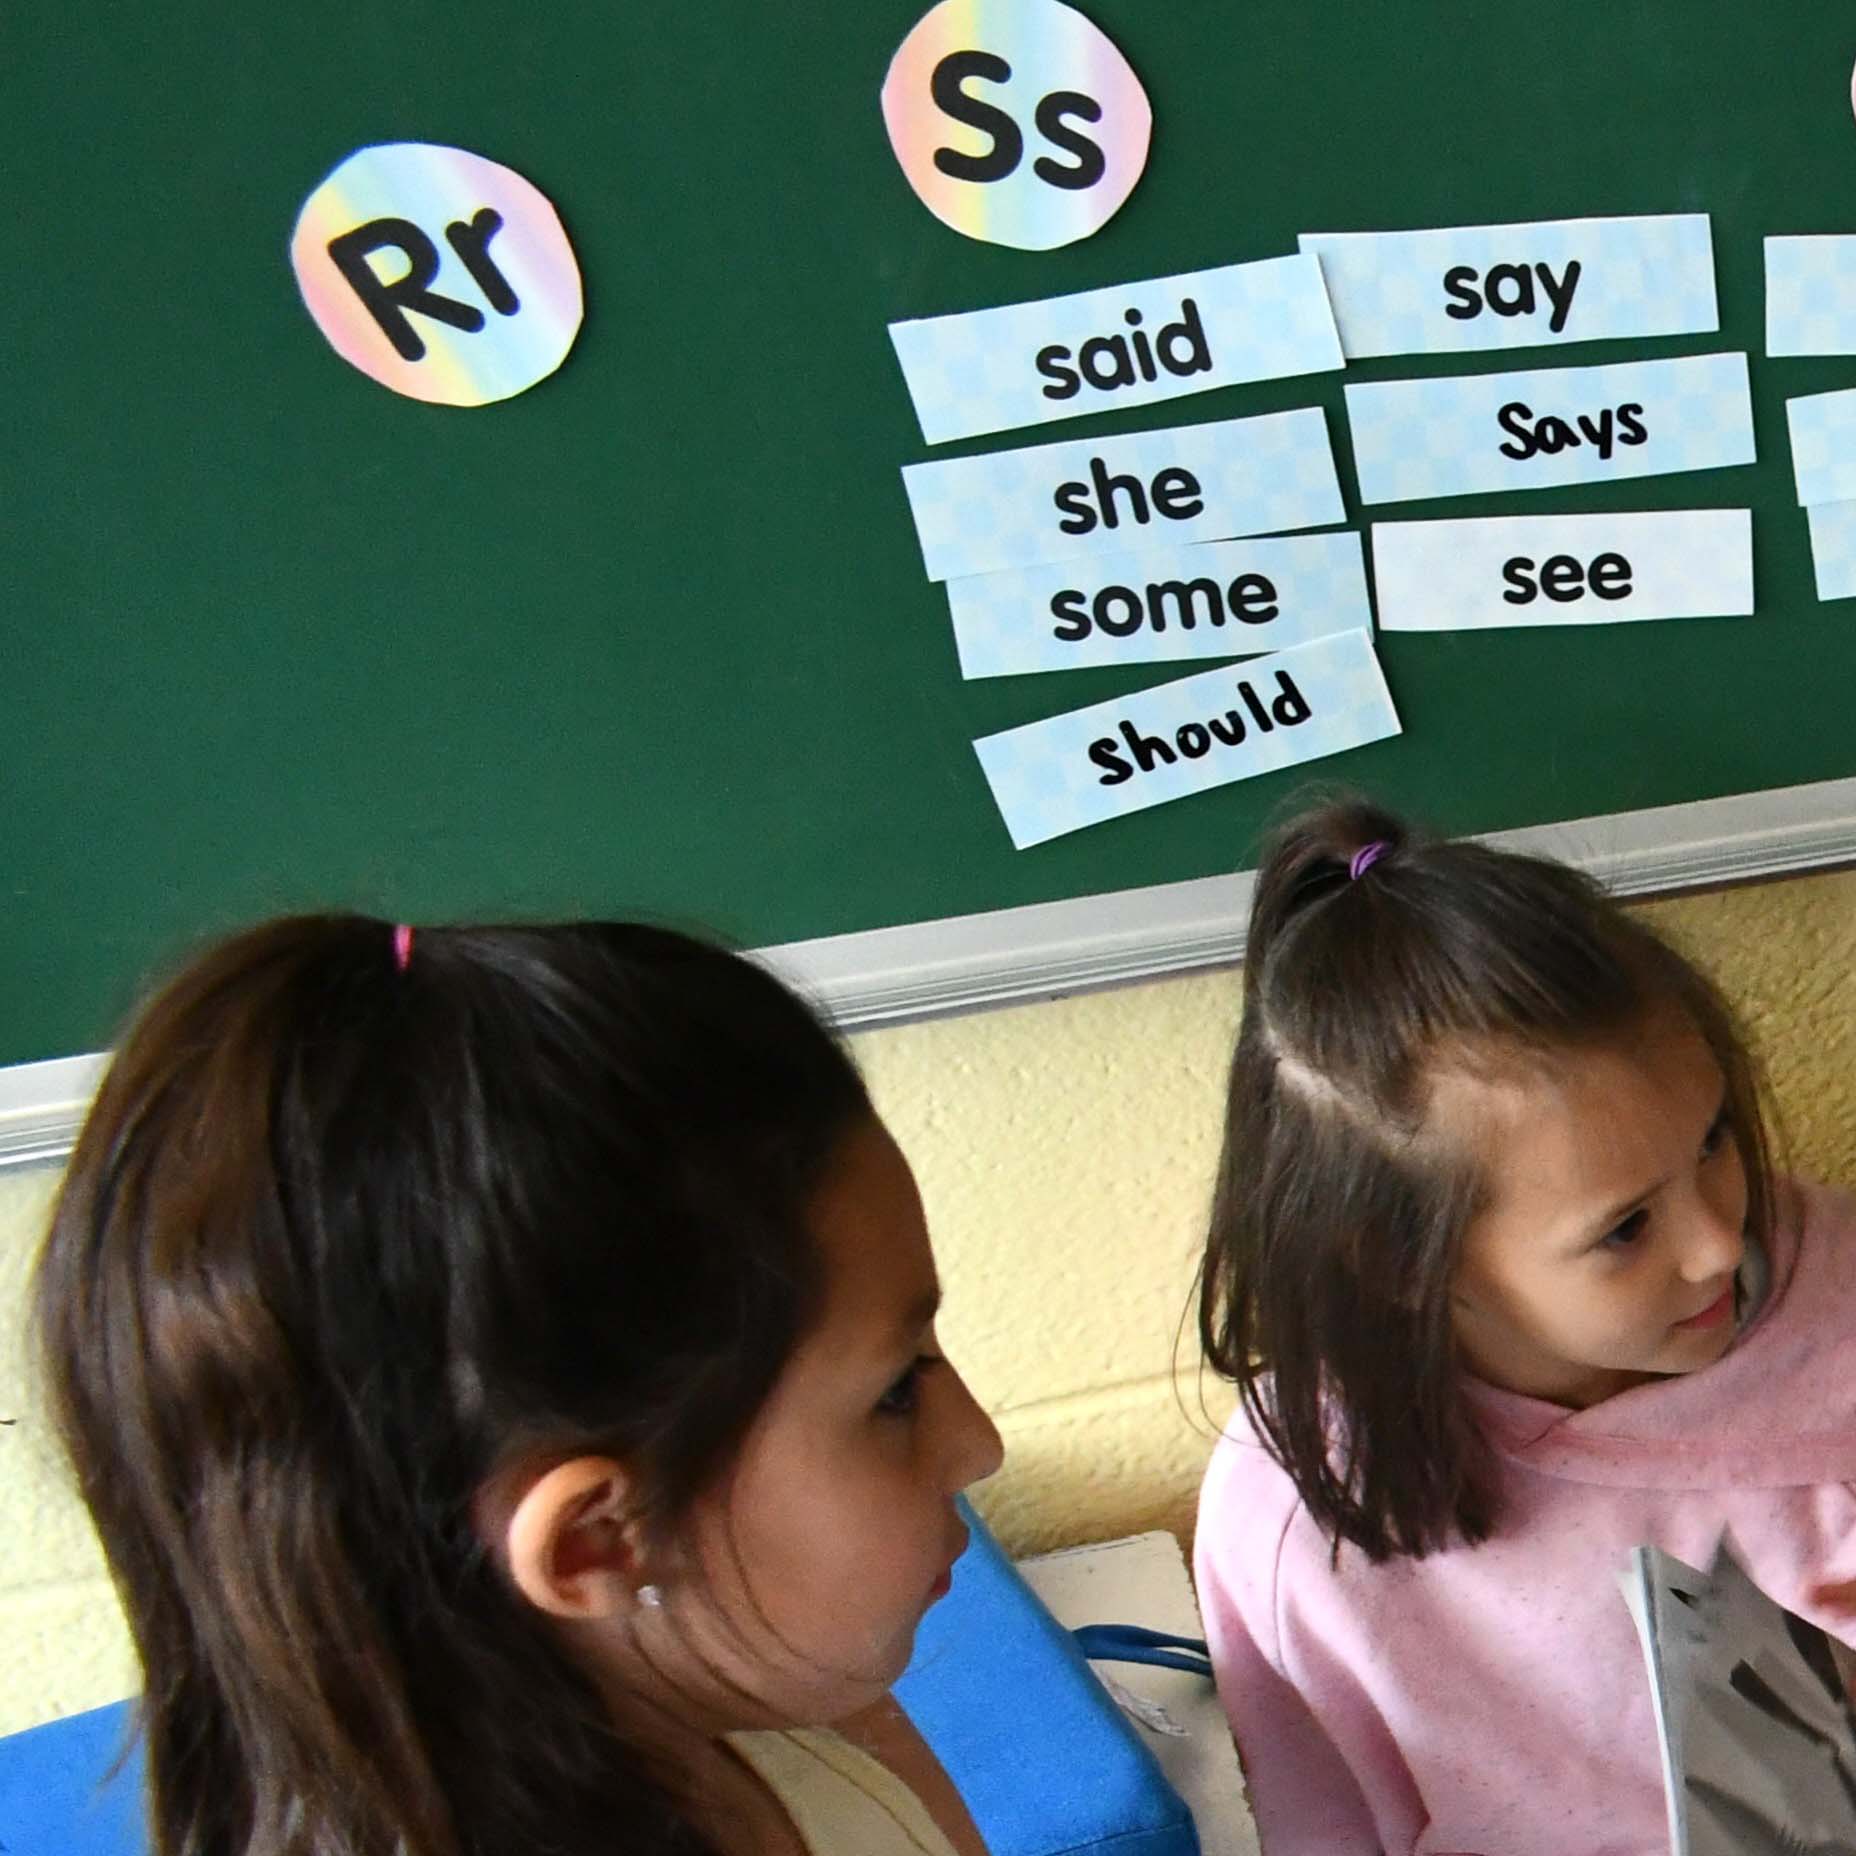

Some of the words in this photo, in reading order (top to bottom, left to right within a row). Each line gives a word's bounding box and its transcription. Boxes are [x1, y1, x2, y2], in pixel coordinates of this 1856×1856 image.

[931, 49, 1106, 191] Ss
[328, 207, 520, 362] Rr
[1444, 261, 1581, 333] say
[1035, 301, 1214, 400] said
[1054, 458, 1203, 534] she
[1051, 574, 1278, 641] some
[1503, 553, 1632, 604] see
[1087, 670, 1312, 786] should
